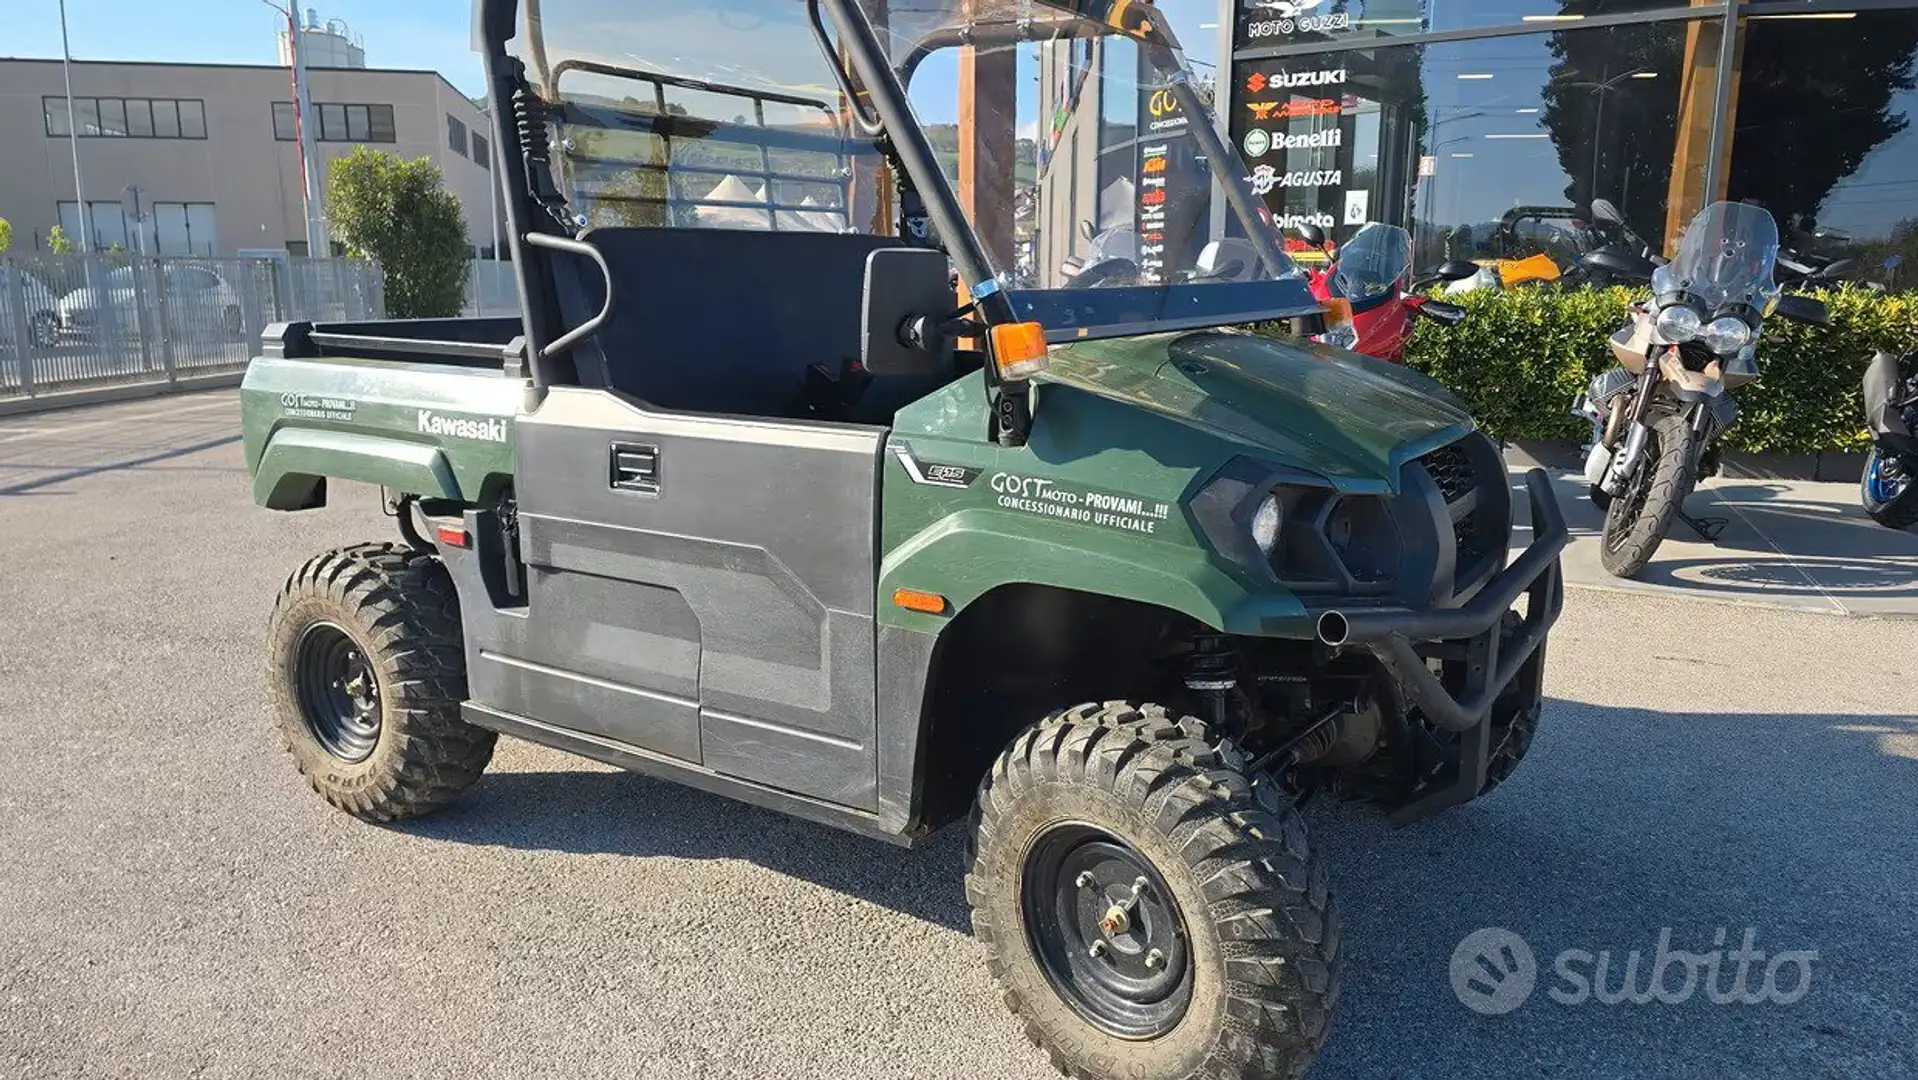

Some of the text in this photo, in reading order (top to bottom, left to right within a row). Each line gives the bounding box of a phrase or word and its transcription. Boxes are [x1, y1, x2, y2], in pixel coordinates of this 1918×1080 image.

[1248, 13, 1348, 37] MOTO GUZZI
[1269, 69, 1346, 88] SUZUKI
[1271, 128, 1342, 150] Benelli
[1280, 170, 1341, 187] AGUSTA
[418, 409, 507, 443] Kawasaki
[997, 495, 1155, 533] CONCESSIONARIO UFFICIALE
